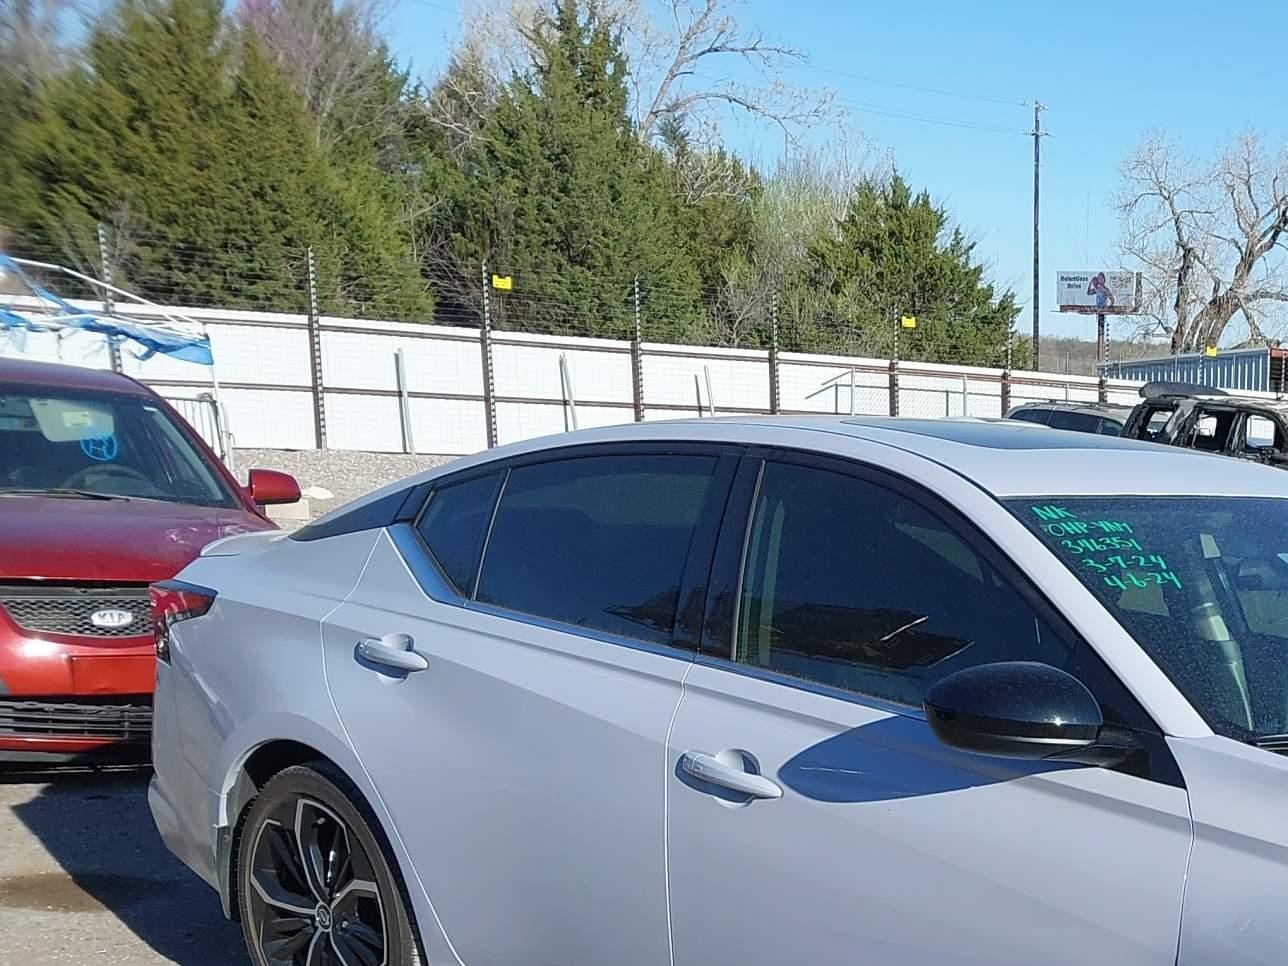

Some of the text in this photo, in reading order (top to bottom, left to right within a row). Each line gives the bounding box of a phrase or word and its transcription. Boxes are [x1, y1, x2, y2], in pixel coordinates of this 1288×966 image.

[1082, 555, 1168, 573] 3-7-24
[1103, 571, 1182, 590] 4-6-24
[97, 612, 130, 624] KIA
